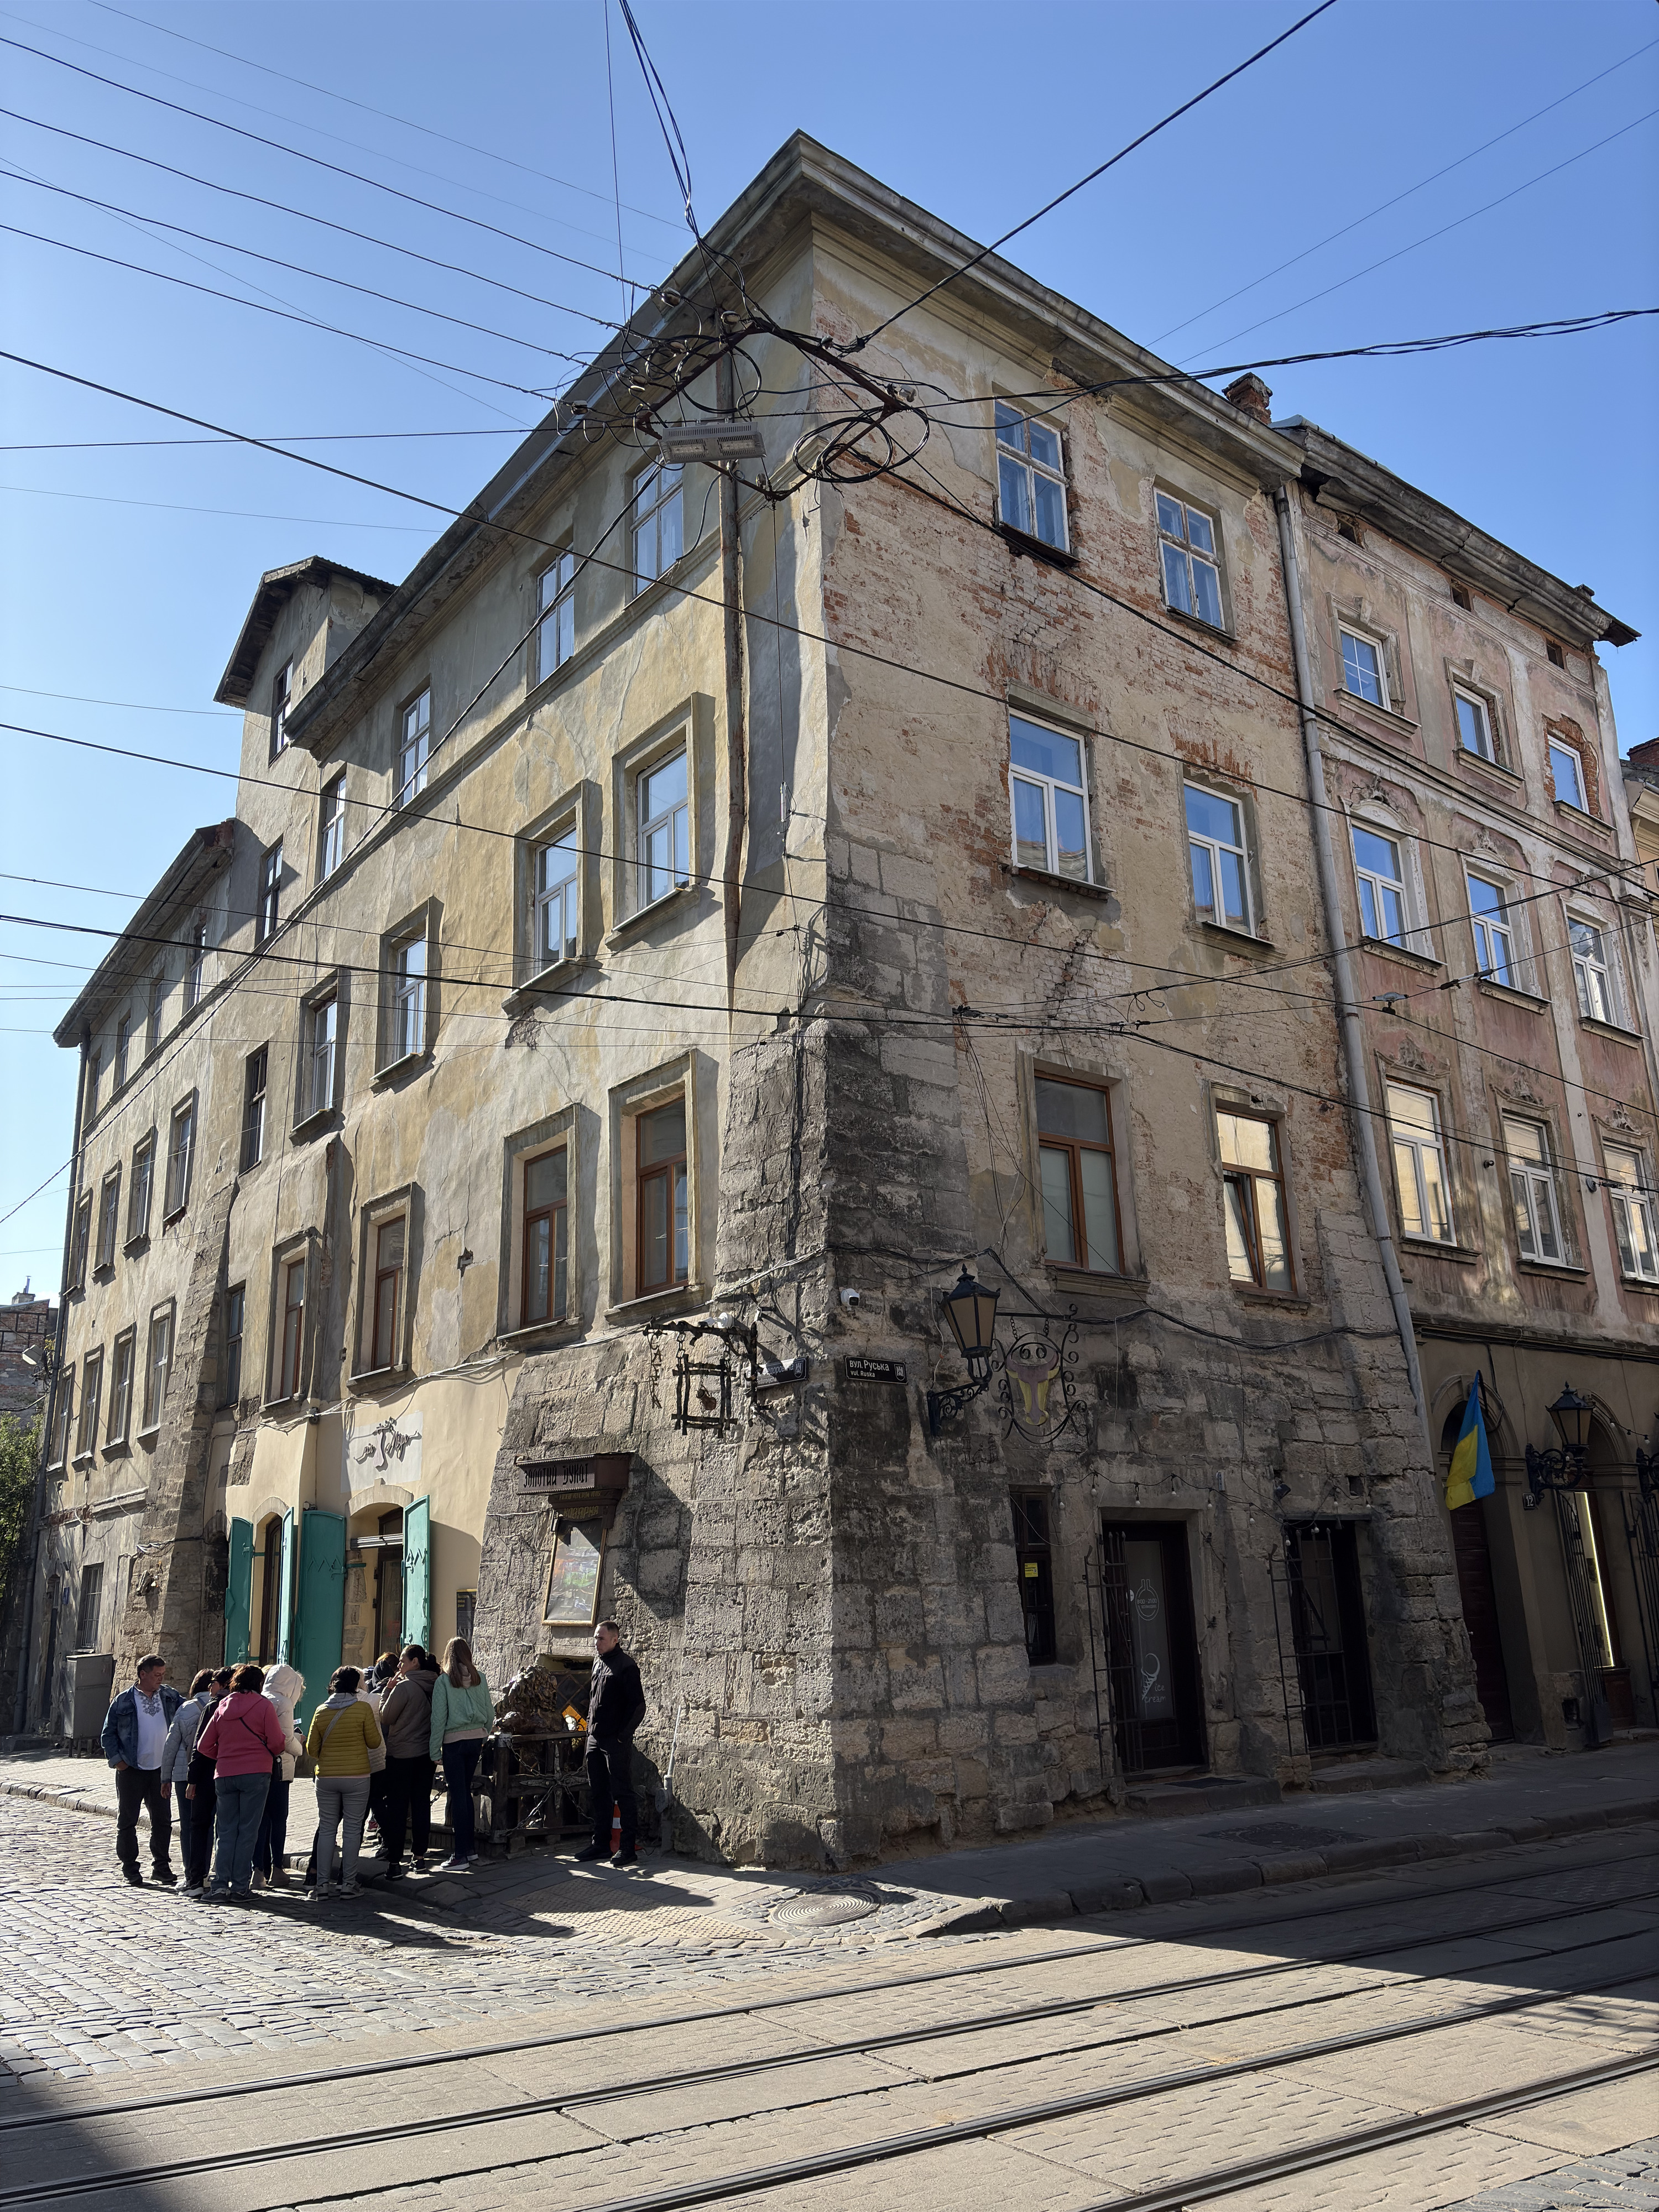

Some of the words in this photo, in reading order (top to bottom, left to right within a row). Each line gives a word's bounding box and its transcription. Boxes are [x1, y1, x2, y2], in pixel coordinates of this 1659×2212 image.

[849, 1360, 863, 1369] вул.
[864, 1360, 889, 1371] Руська
[524, 1465, 557, 1488] ЗОЛОТИЙ
[562, 1463, 588, 1485] ДУКАТ
[1526, 1495, 1533, 1506] 12
[1155, 1683, 1165, 1692] ice
